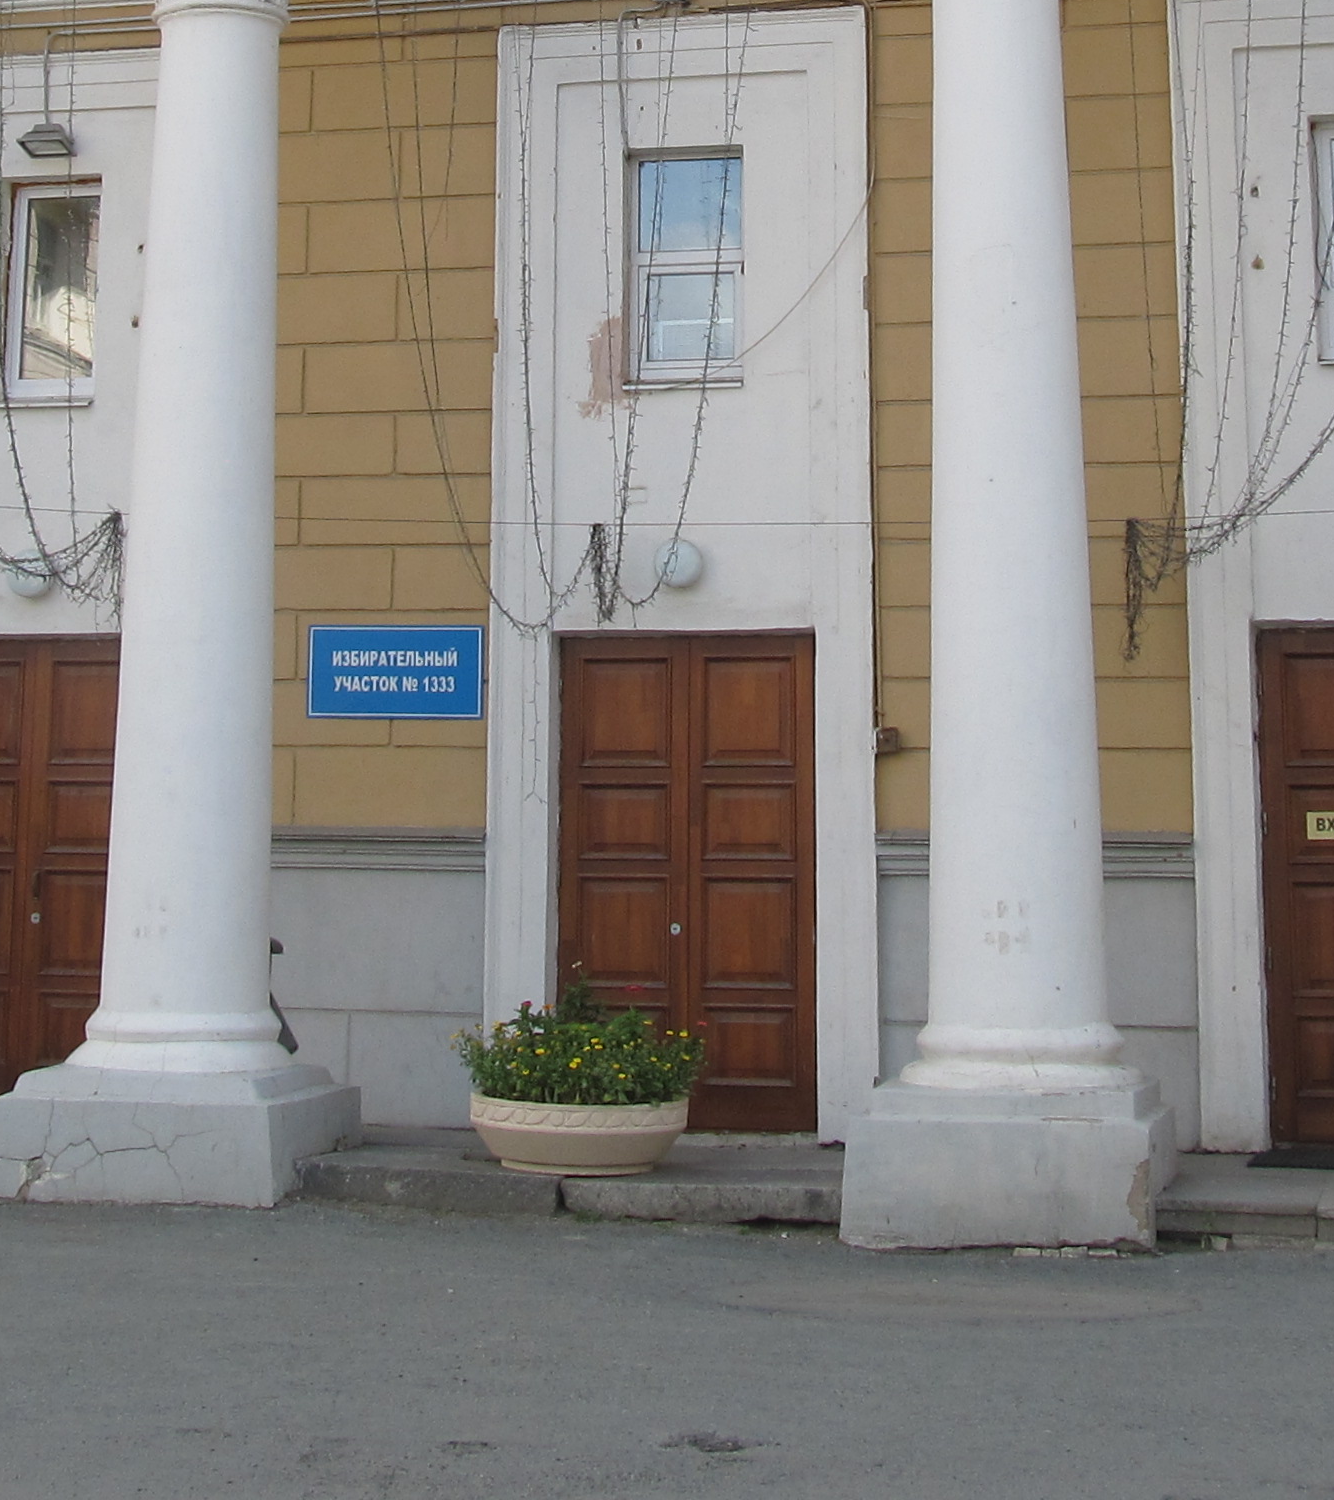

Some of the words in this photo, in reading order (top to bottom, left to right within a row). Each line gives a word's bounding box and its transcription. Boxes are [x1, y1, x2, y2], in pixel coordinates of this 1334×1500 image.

[332, 647, 458, 667] ИЗБИРАТЕЛЬНЫЙ
[334, 676, 398, 692] УЧАСТОК
[402, 676, 418, 692] №
[423, 676, 455, 693] 1333
